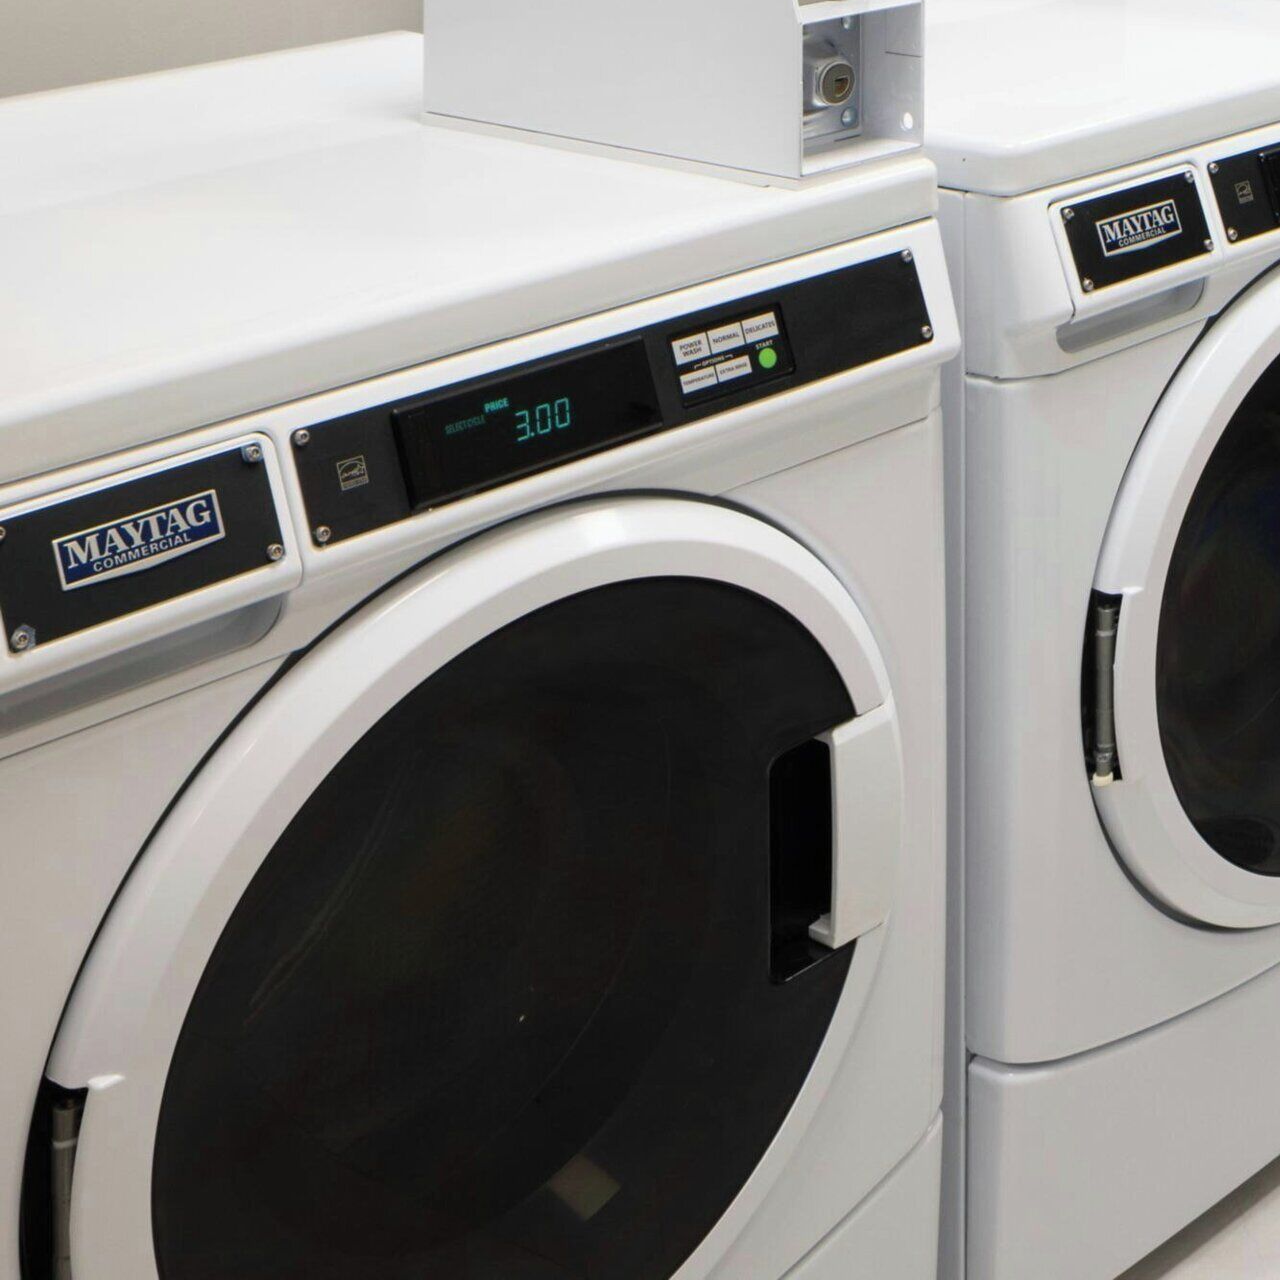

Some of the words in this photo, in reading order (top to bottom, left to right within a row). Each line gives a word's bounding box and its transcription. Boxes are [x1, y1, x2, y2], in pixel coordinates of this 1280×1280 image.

[1102, 205, 1175, 243] MAYTAG
[1118, 226, 1167, 247] COMMERCIAL
[712, 331, 740, 344] NORMAL
[682, 347, 703, 358] WASH
[484, 397, 510, 413] PRICE
[514, 397, 571, 441] 3.00
[62, 499, 212, 570] MAYTAG
[93, 532, 192, 572] COMMERCIAL
